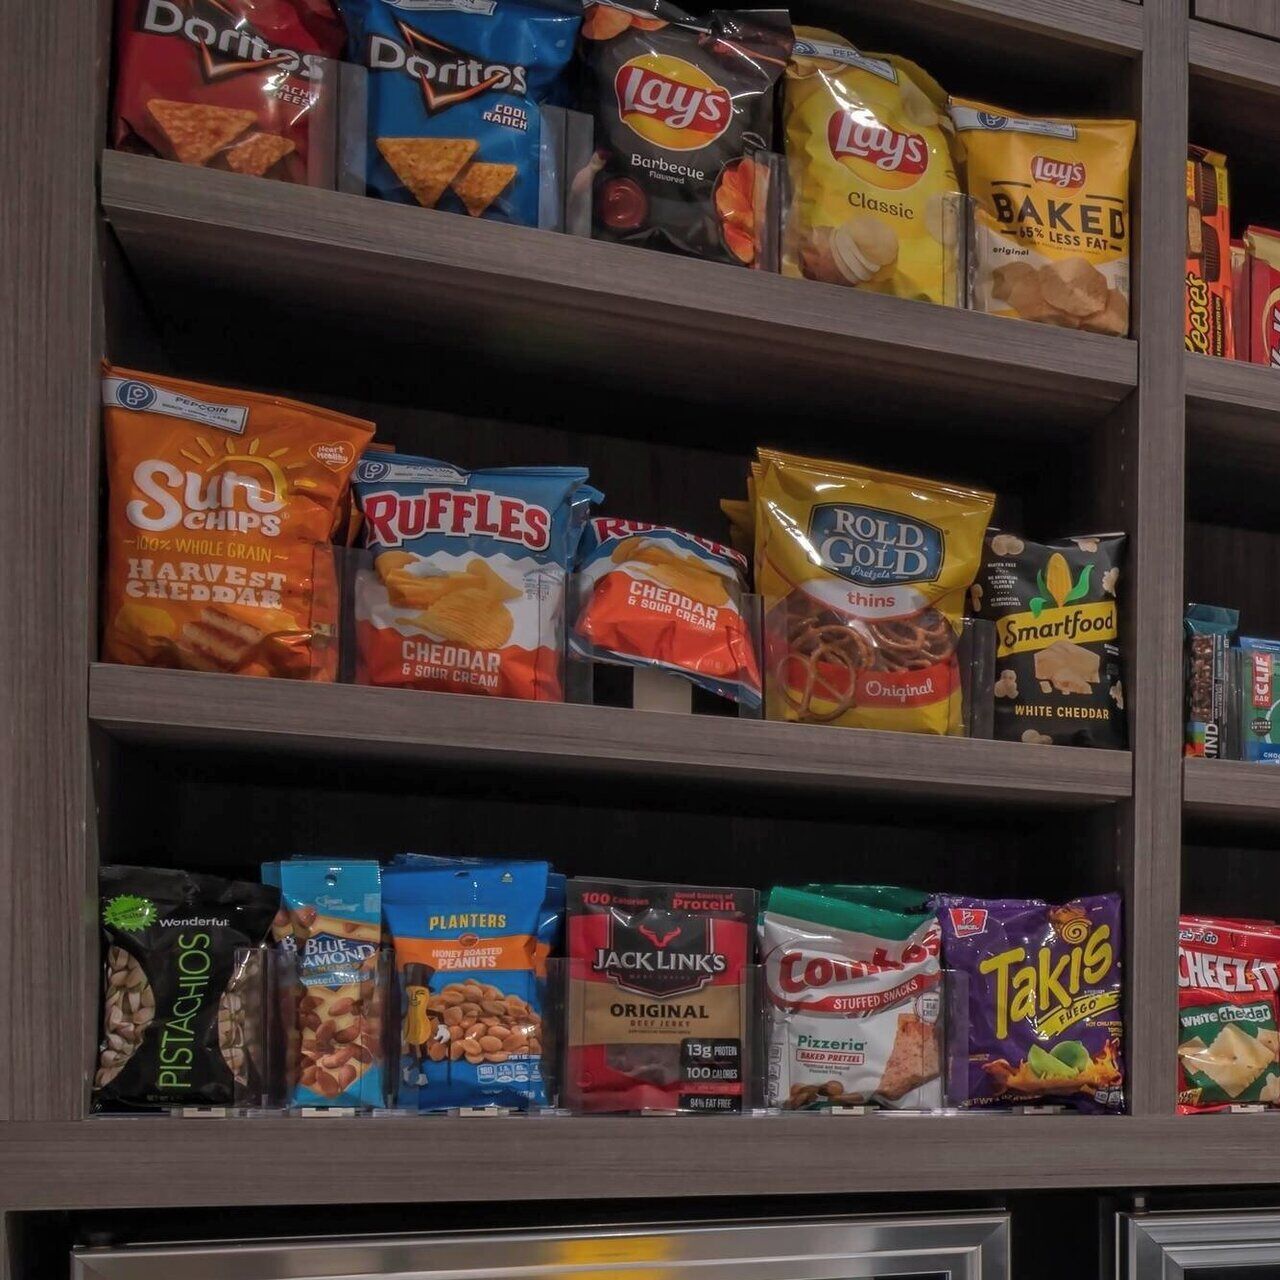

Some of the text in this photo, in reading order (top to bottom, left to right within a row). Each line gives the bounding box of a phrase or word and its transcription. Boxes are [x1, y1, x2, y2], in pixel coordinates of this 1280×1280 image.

[143, 0, 324, 81] Doritos
[371, 35, 526, 94] Doritos
[623, 68, 731, 130] Lay's
[483, 111, 527, 130] RANCH
[495, 104, 528, 119] COOL
[832, 113, 928, 171] Lay's
[631, 154, 705, 181] Barbecue
[1034, 156, 1083, 187] Lay's
[848, 191, 914, 220] Classic
[994, 191, 1126, 238] BAKED
[1049, 230, 1081, 246] LESS
[1085, 235, 1109, 251] FAT
[184, 510, 281, 537] CHIPS
[365, 488, 551, 552] RUFFLES
[833, 507, 925, 549] ROLD
[136, 538, 272, 562] 100% WHOLE GRAIN
[821, 537, 928, 576] GOLD
[128, 558, 286, 591] HARVEST
[126, 580, 282, 610] CHEDDAR
[629, 579, 719, 622] CHEDDAR
[847, 590, 895, 608] thins
[641, 598, 716, 632] SOUR CREAM
[1004, 607, 1115, 649] Smartfood
[402, 640, 500, 672] CHEDDAR
[415, 665, 498, 687] SOUR CREAM
[1254, 654, 1270, 696] CLIF
[865, 677, 933, 698] Original
[1014, 704, 1110, 720] WHITE CHEDDAR
[582, 892, 610, 905] 100
[673, 899, 735, 911] Protein
[159, 918, 229, 927] Wonderful
[429, 914, 506, 931] PLANTERS
[305, 938, 349, 956] BLUE
[1203, 933, 1218, 944] Go
[432, 947, 502, 958] HONEY ROASTED
[438, 957, 496, 969] PEANUTS
[593, 950, 725, 972] JACK LINK'S
[833, 981, 919, 1010] STUFFED SNACKS
[158, 933, 210, 1088] PISTACHIOS
[610, 1004, 709, 1019] ORIGINAL
[1059, 1000, 1097, 1025] FUEGO
[1181, 1014, 1218, 1027] WHITE
[687, 1044, 738, 1058] 13g PROTEIN
[797, 1035, 864, 1051] Pizzeria
[799, 1052, 861, 1064] BAKED PRETZEL
[687, 1067, 738, 1079] 100 CALORIES
[717, 1098, 731, 1108] FREE
